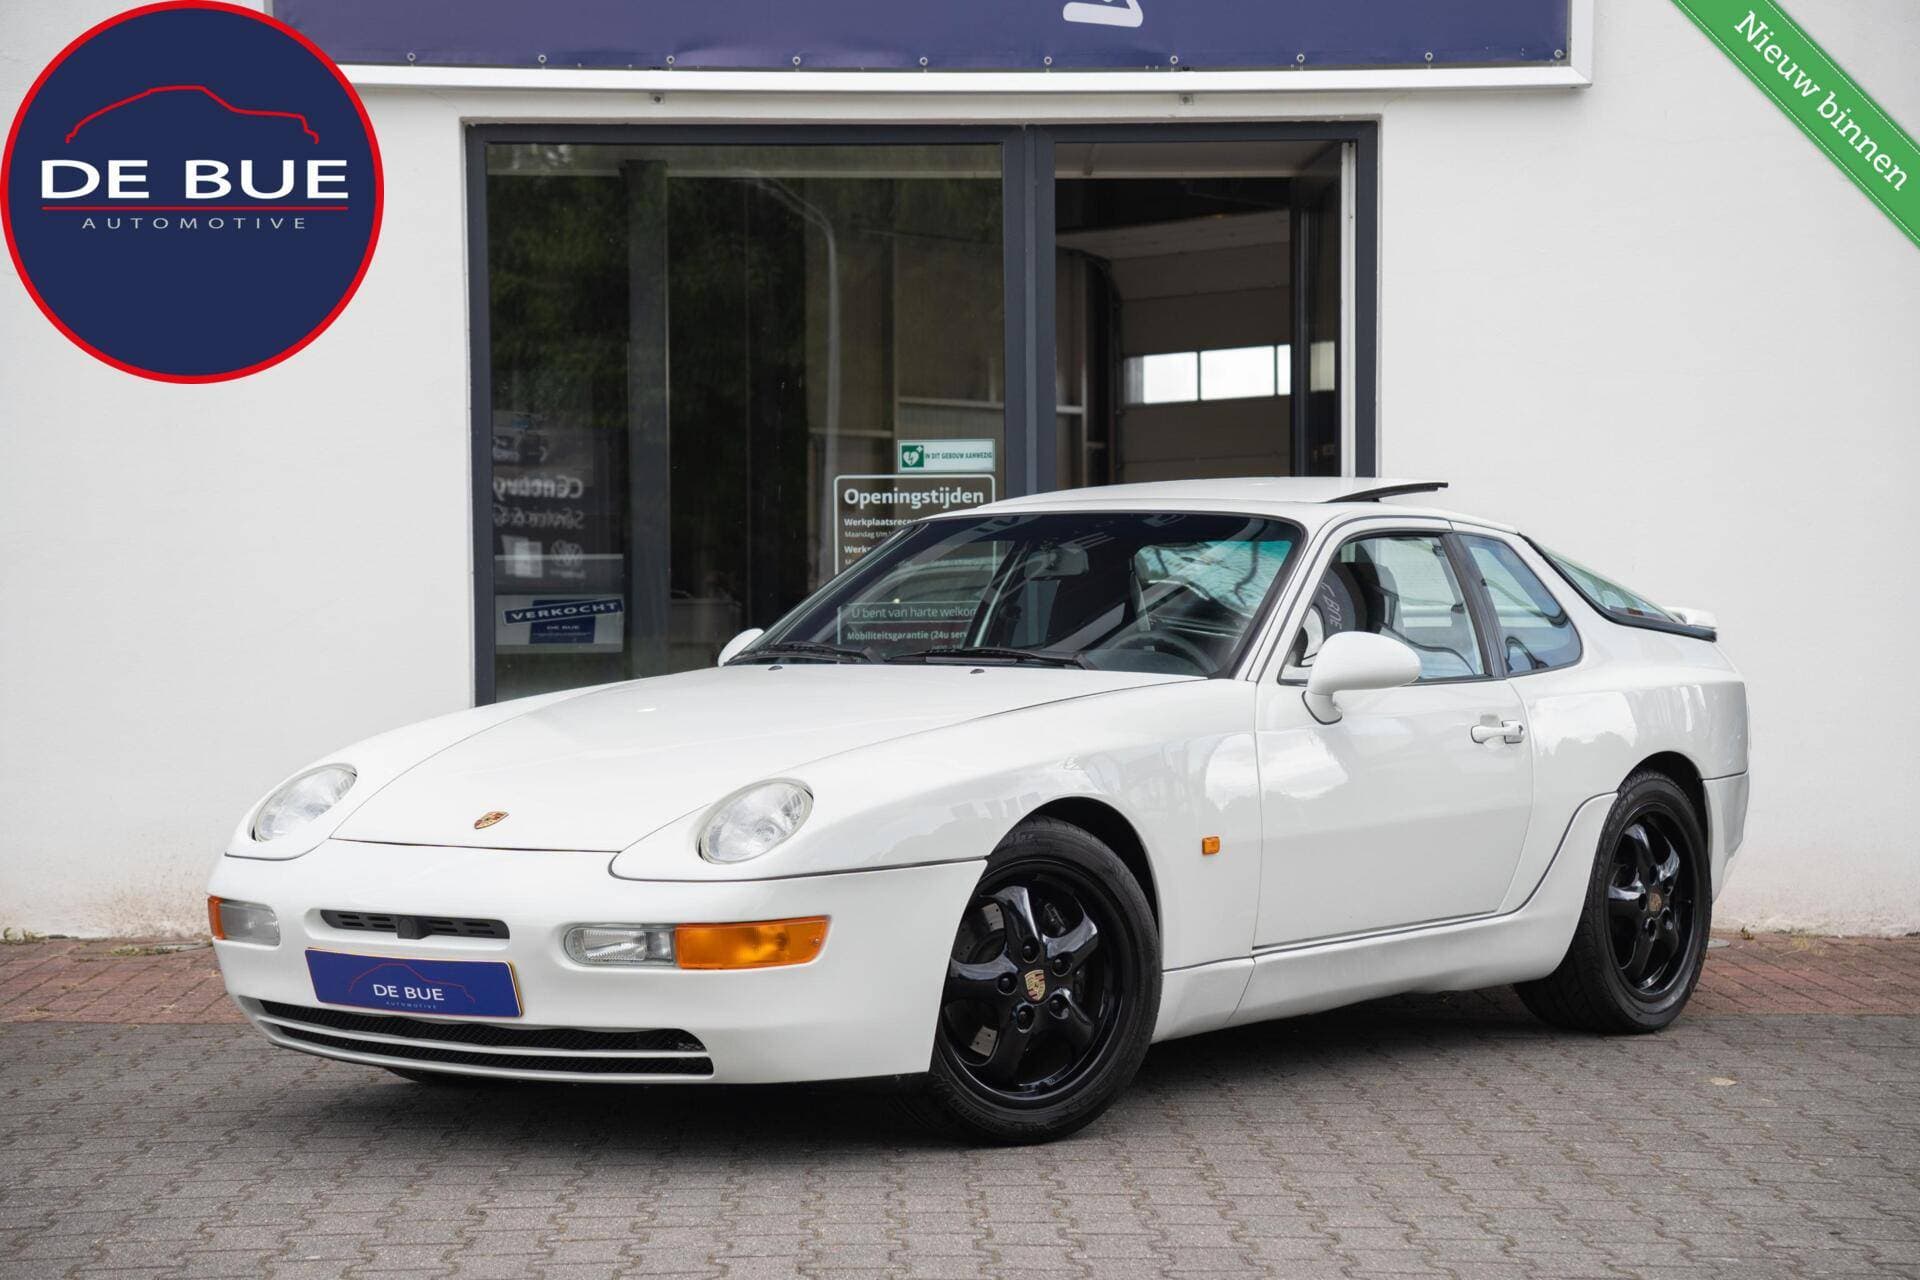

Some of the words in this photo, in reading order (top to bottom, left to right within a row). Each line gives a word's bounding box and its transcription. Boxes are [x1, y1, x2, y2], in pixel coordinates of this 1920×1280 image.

[931, 452, 941, 460] DIT
[942, 452, 964, 460] GEBOUW
[965, 451, 992, 459] AANWEZIG
[844, 487, 984, 510] Openingstijden
[844, 518, 912, 528] Werkplaatsrece
[844, 531, 875, 539] Maandag
[512, 602, 617, 620] VERKOCHT
[852, 608, 860, 618] U
[863, 607, 887, 618] bent
[888, 609, 908, 618] van
[910, 607, 937, 617] harte
[847, 630, 929, 641] Mobiliteitsgarantie
[373, 984, 399, 998] DE
[404, 986, 445, 1001] BUE
